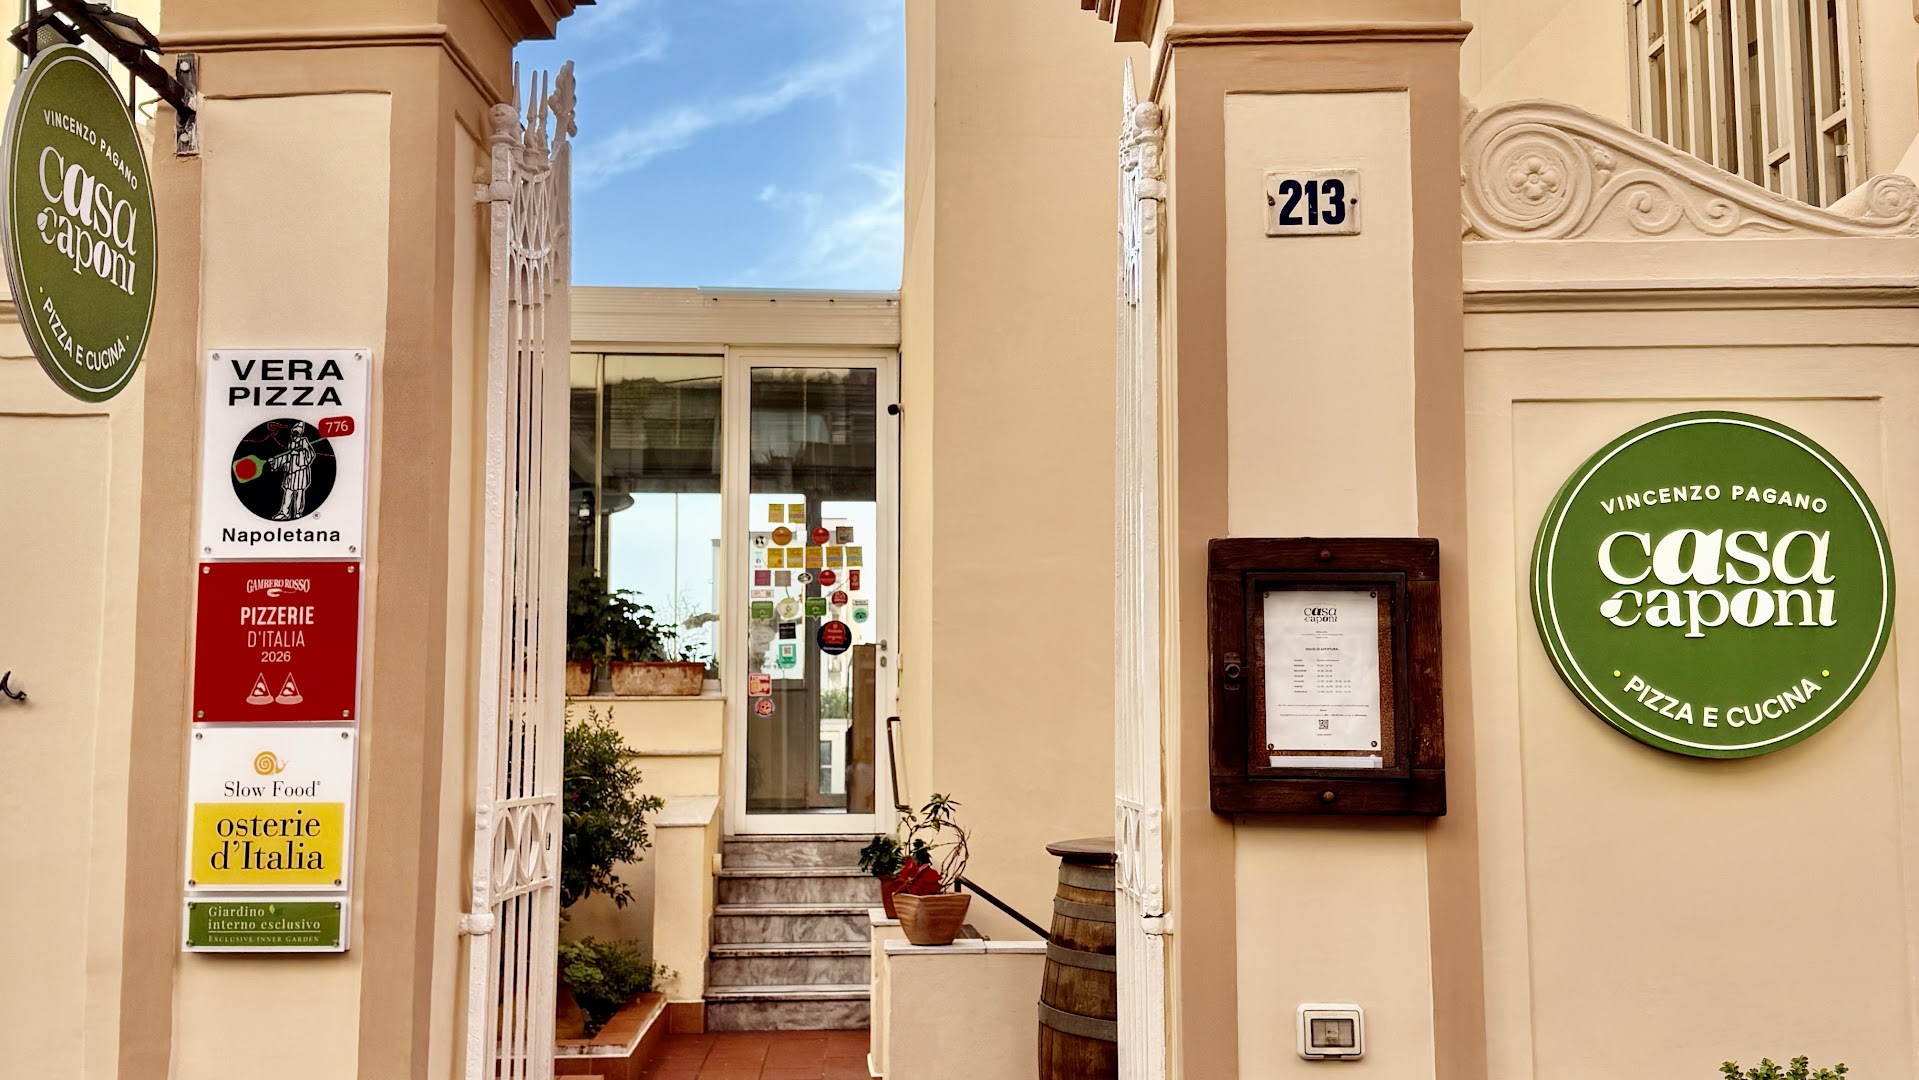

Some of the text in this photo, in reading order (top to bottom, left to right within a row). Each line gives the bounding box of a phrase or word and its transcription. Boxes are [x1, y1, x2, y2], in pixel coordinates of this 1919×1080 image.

[44, 109, 138, 190] VINCENZO PAGANO
[39, 146, 137, 256] casa
[1279, 179, 1345, 225] 213
[37, 207, 136, 296] caponi
[43, 297, 126, 371] PIZZA E CUCINA
[231, 359, 344, 381] VERA
[229, 386, 342, 406] PIZZA
[325, 420, 348, 433] 776
[1599, 484, 1828, 515] VINCENZO PAGANO
[222, 528, 340, 545] Napoletana
[1597, 528, 1836, 586] casa
[246, 578, 311, 593] GAMBERO ROSSO
[240, 606, 315, 625] PIZZERIE
[1303, 607, 1337, 616] casa
[1599, 588, 1838, 638] caponi
[247, 630, 306, 647] D'ITALIA
[261, 651, 291, 662] 2026
[1623, 675, 1822, 728] PIZZA E CUCINA
[224, 781, 266, 797] Slow
[216, 810, 321, 837] osterie
[210, 841, 325, 870] d’Italia
[208, 906, 265, 917] Giardino
[208, 919, 320, 930] interno esclusivo
